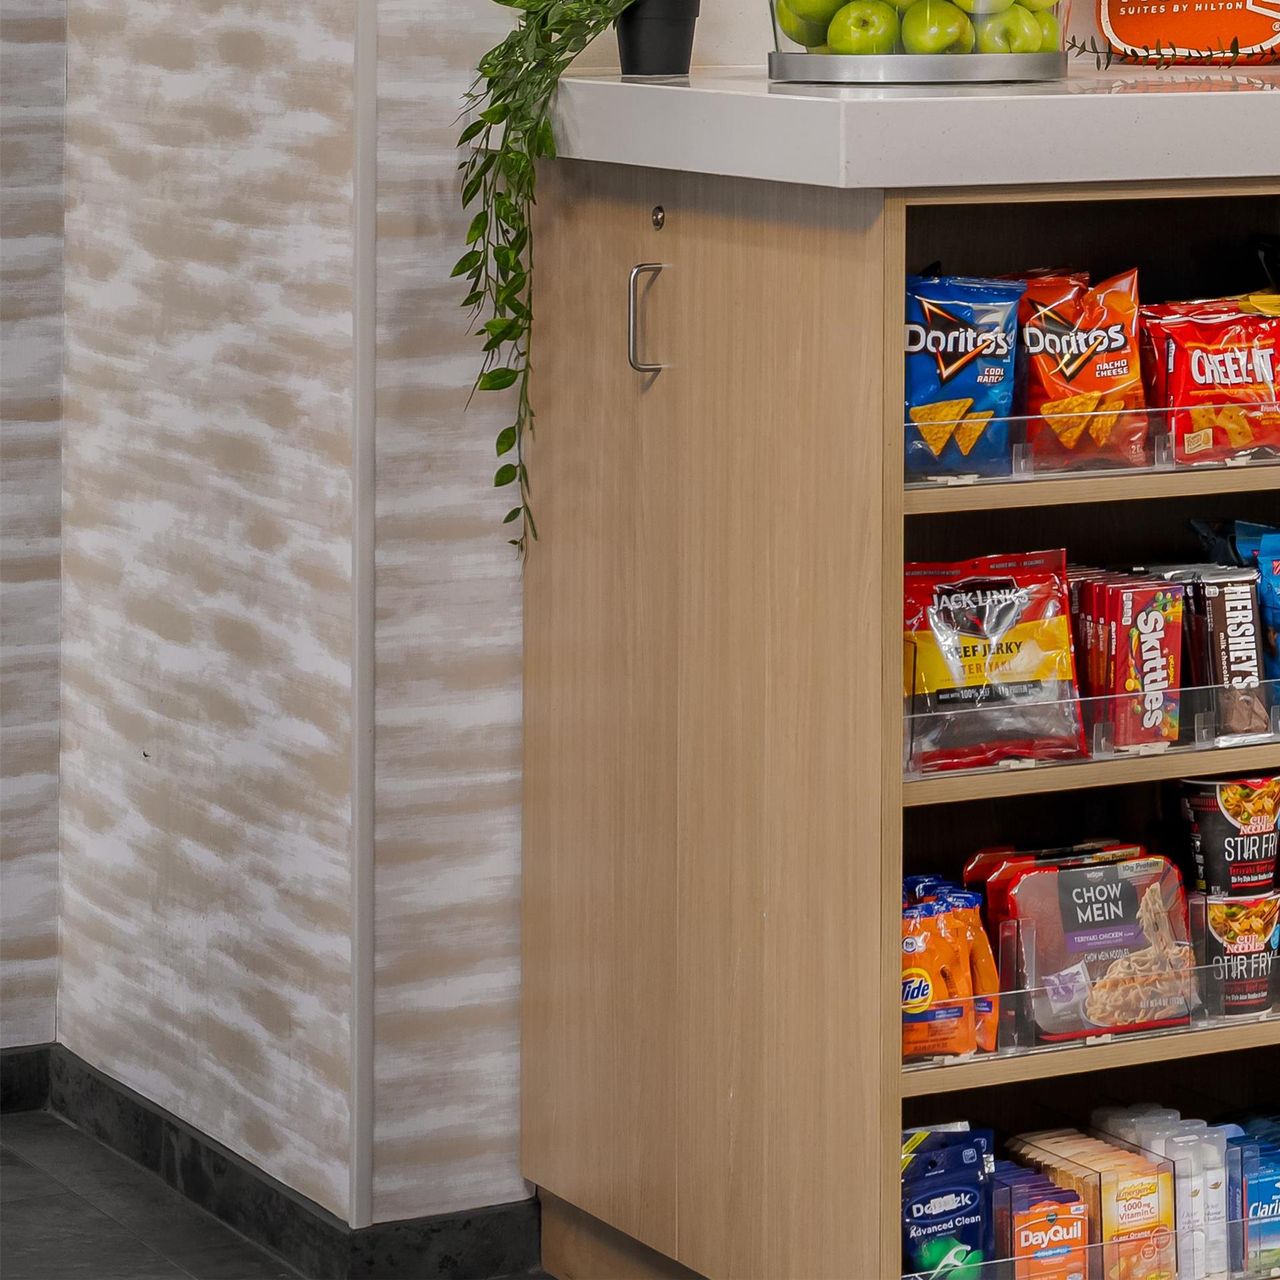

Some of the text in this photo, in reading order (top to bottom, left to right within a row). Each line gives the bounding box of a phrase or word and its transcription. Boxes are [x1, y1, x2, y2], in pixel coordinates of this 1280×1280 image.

[1120, 1, 1243, 16] SUITES BY HILTON
[904, 323, 1008, 355] Doritos
[1023, 324, 1126, 354] Doritos
[985, 367, 1004, 375] COOL
[1095, 366, 1129, 378] CHEESE
[1096, 359, 1127, 371] NACHO
[1191, 347, 1275, 385] CHEEZ-IT
[1224, 583, 1260, 690] HERSHEY'S
[1136, 610, 1169, 729] Skittles
[1250, 815, 1270, 824] CUP
[1240, 823, 1275, 835] NOODLES
[1224, 835, 1260, 862] STIR
[1122, 860, 1160, 873] 10g Protein
[1072, 882, 1123, 904] CHOW
[1076, 900, 1124, 924] MEIN
[1098, 931, 1123, 940] CHICKEN
[1236, 934, 1259, 944] CUP
[1225, 943, 1266, 954] NOODLES
[1213, 951, 1273, 980] STIR FRY
[902, 977, 930, 1002] Tide
[1119, 1206, 1156, 1221] Vitamin C
[910, 1215, 982, 1239] Advanced Clean
[1020, 1220, 1082, 1248] DayQuil
[1130, 1230, 1151, 1240] Orange
